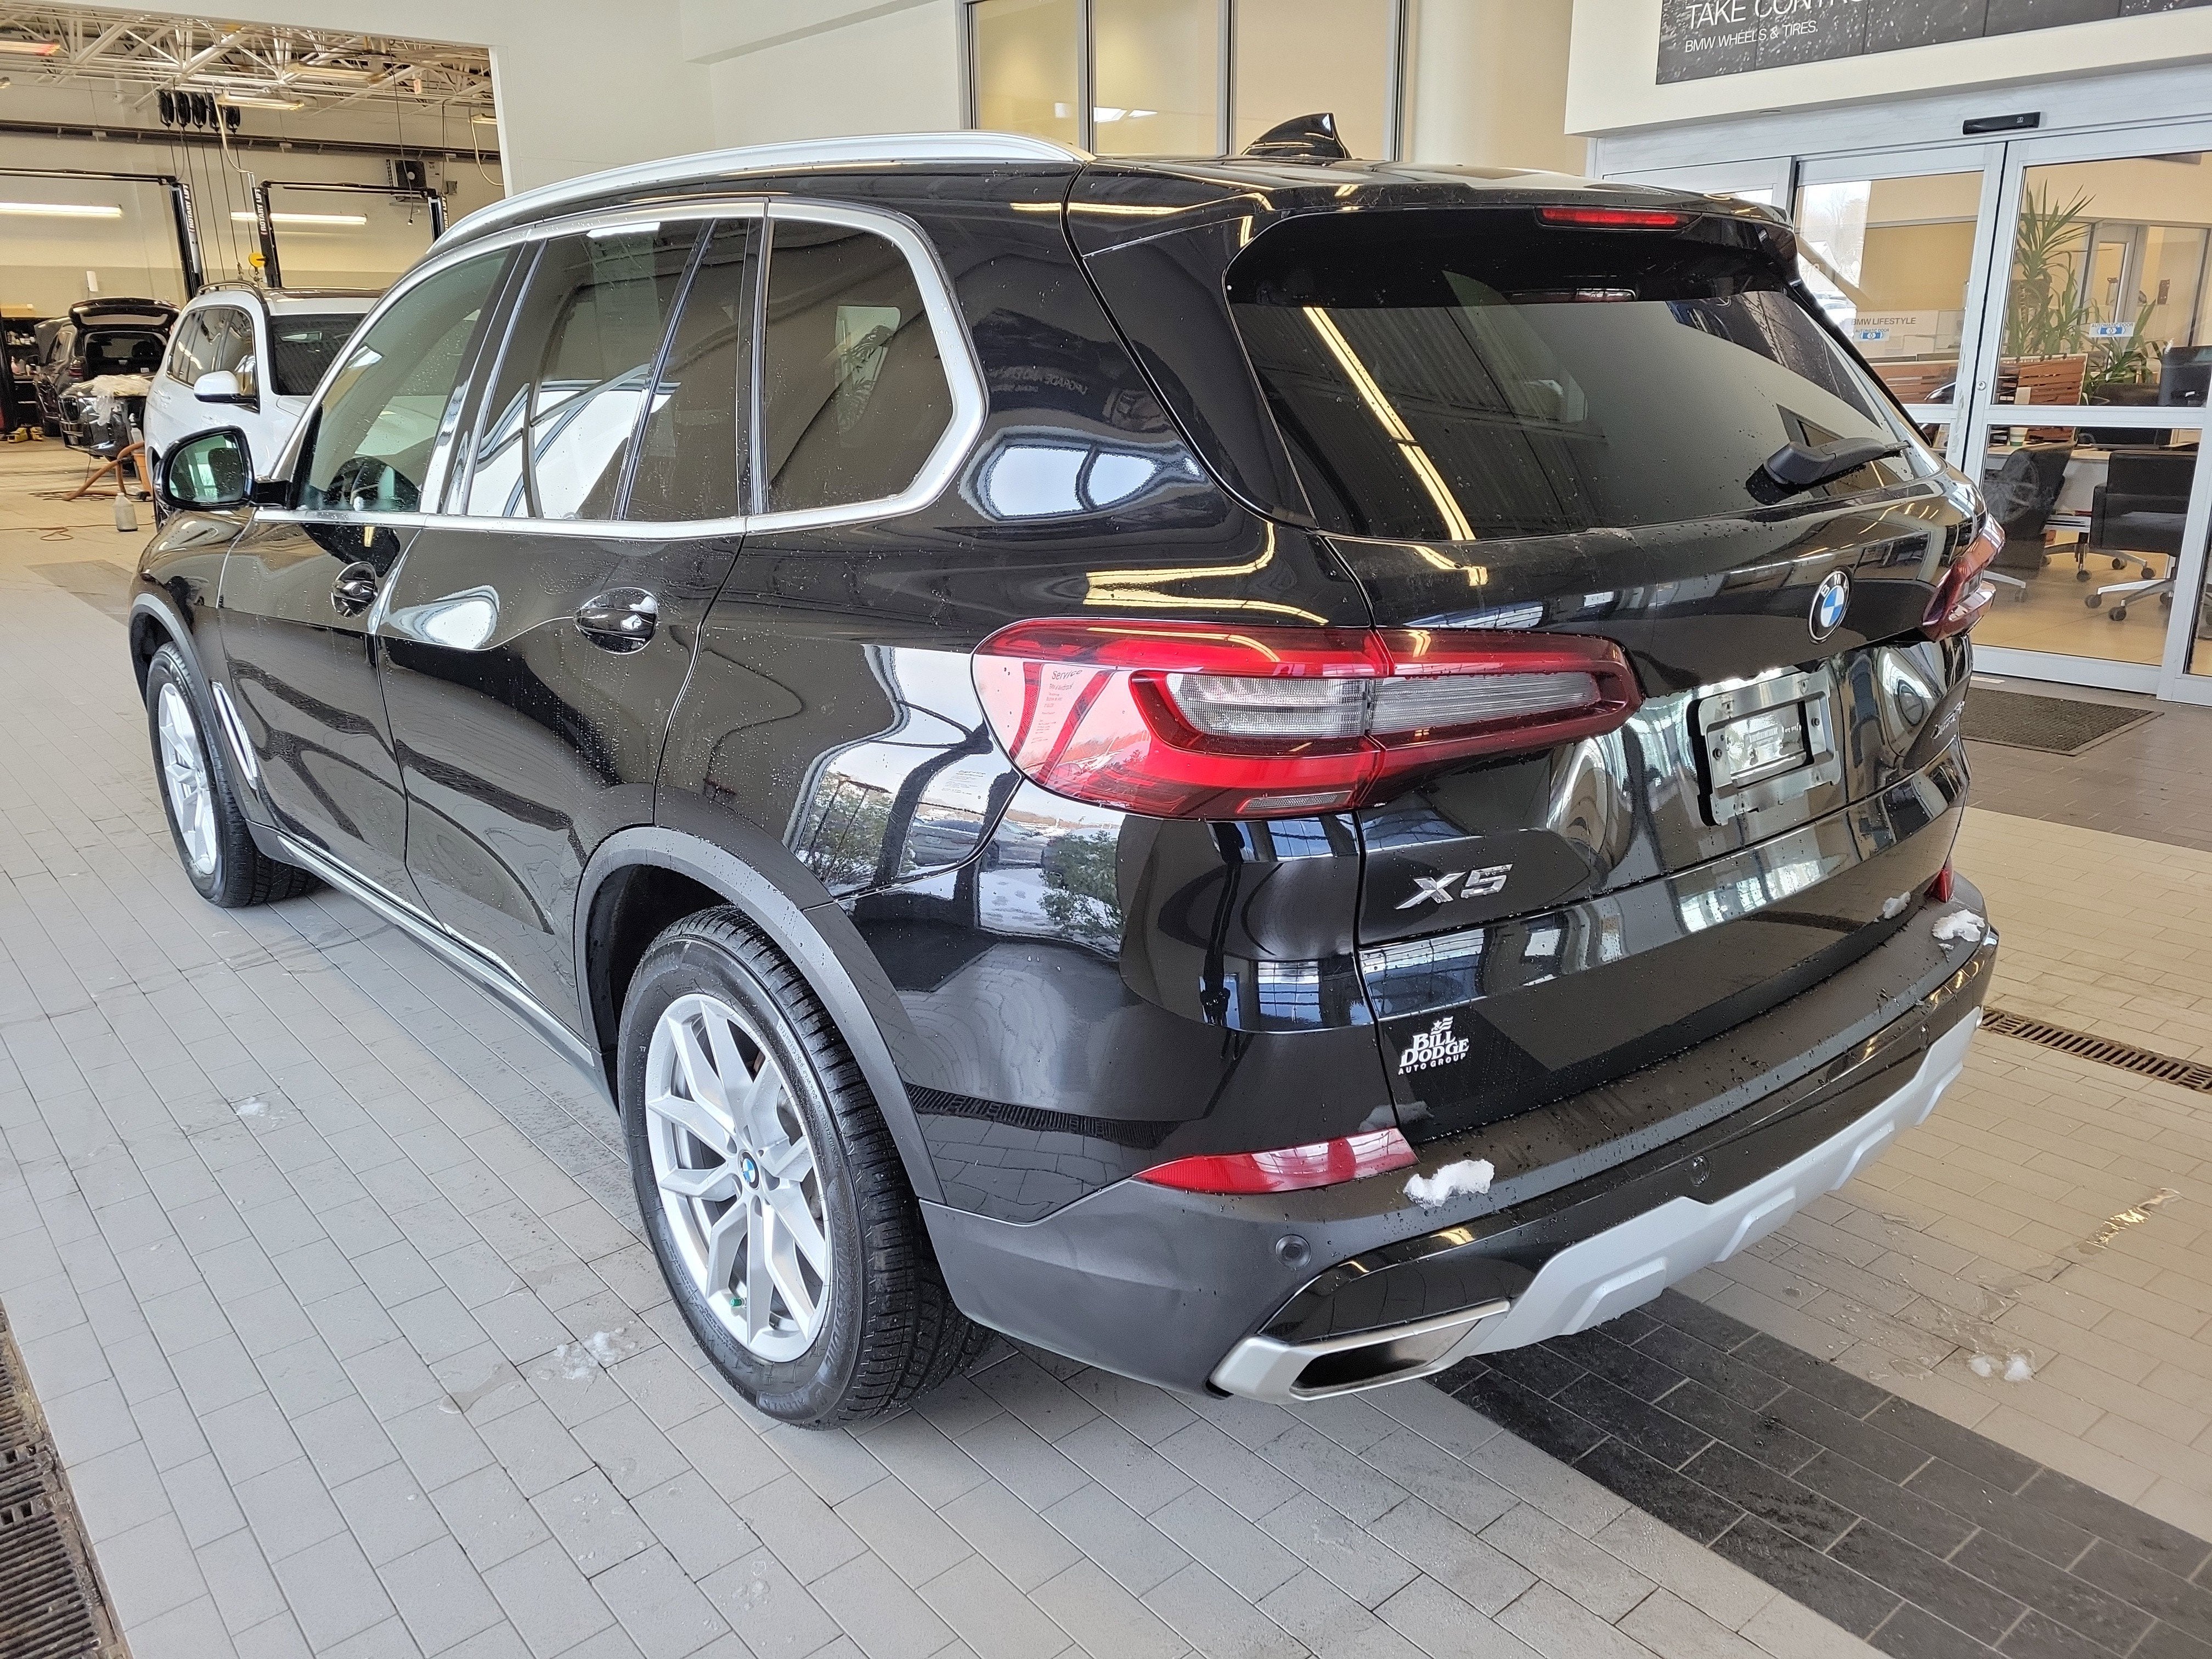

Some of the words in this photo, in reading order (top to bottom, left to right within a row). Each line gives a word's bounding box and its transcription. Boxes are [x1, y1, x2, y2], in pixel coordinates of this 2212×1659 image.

[1685, 0, 1746, 29] TAKE
[1685, 36, 1716, 53] BMW
[1718, 28, 1767, 47] WHEELS
[1770, 25, 1779, 39] &
[1782, 20, 1819, 36] TIRES.
[182, 184, 190, 200] LIFT
[1052, 670, 1083, 680] Service
[1395, 864, 1513, 910] X5
[1398, 1063, 1427, 1075] AUTO
[1430, 1053, 1466, 1068] GROUP
